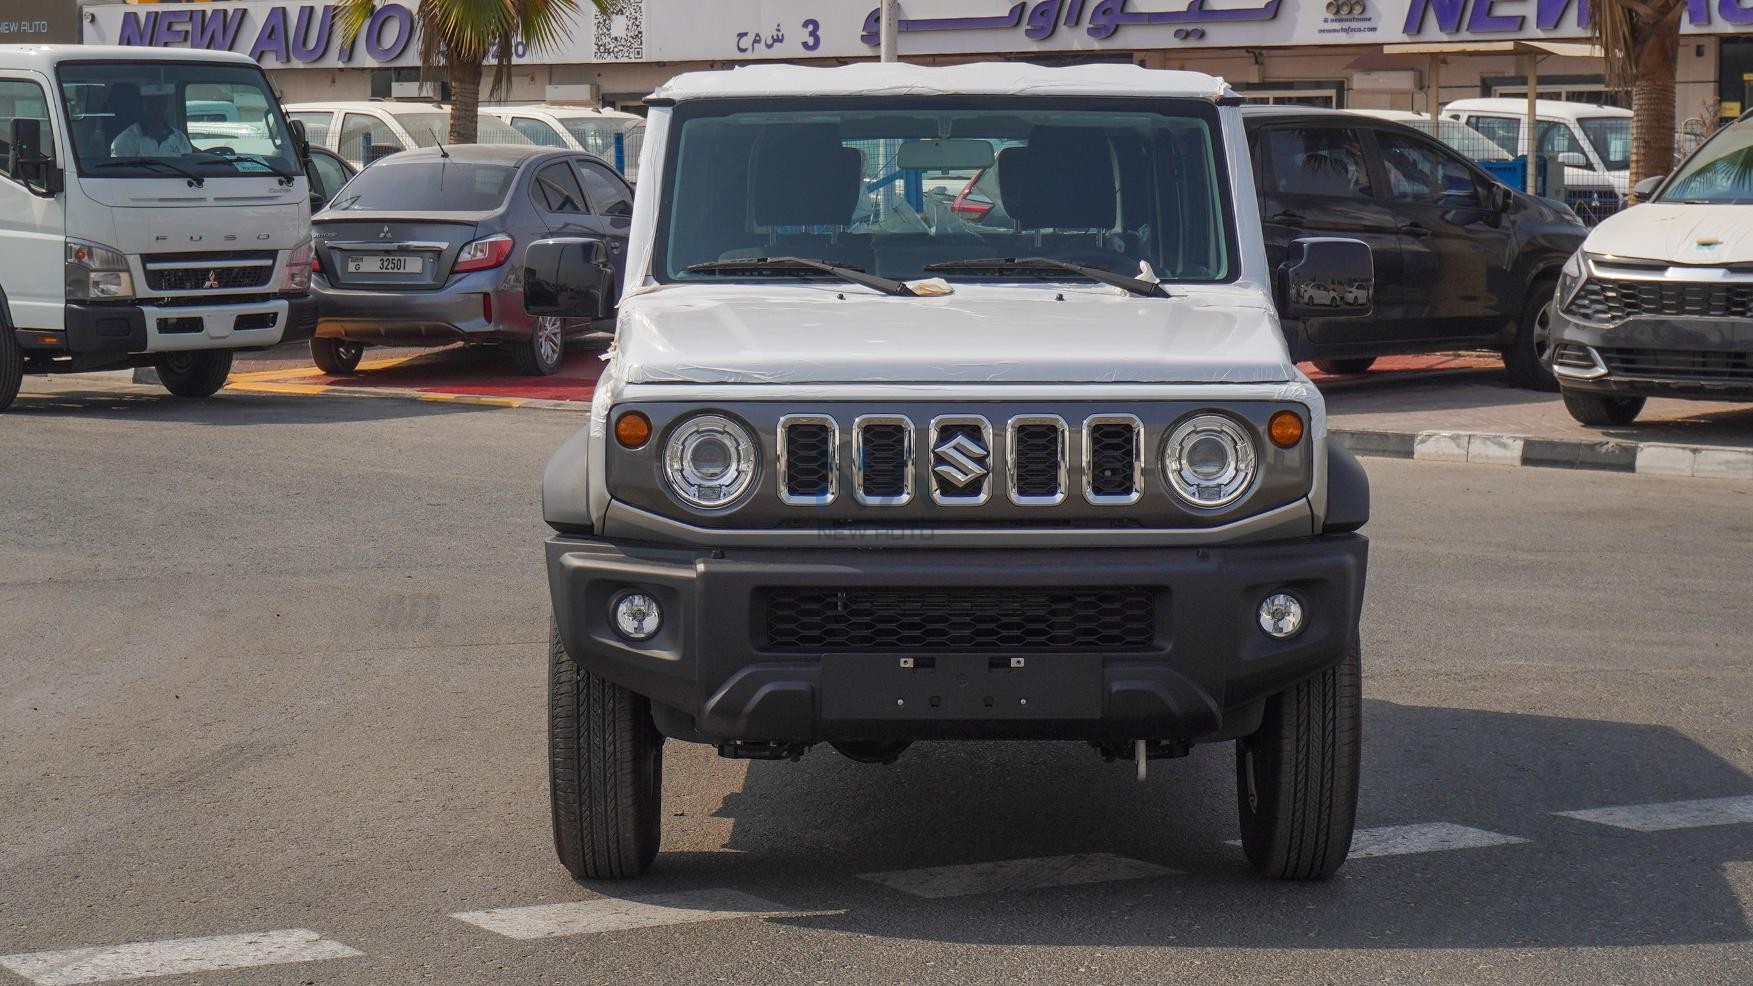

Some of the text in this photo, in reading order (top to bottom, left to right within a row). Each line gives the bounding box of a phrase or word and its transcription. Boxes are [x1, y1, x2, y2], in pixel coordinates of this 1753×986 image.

[20, 20, 48, 33] AUTO
[118, 8, 248, 52] NEW
[801, 18, 821, 52] 3
[155, 233, 270, 242] FUSO
[379, 257, 407, 271] 32501
